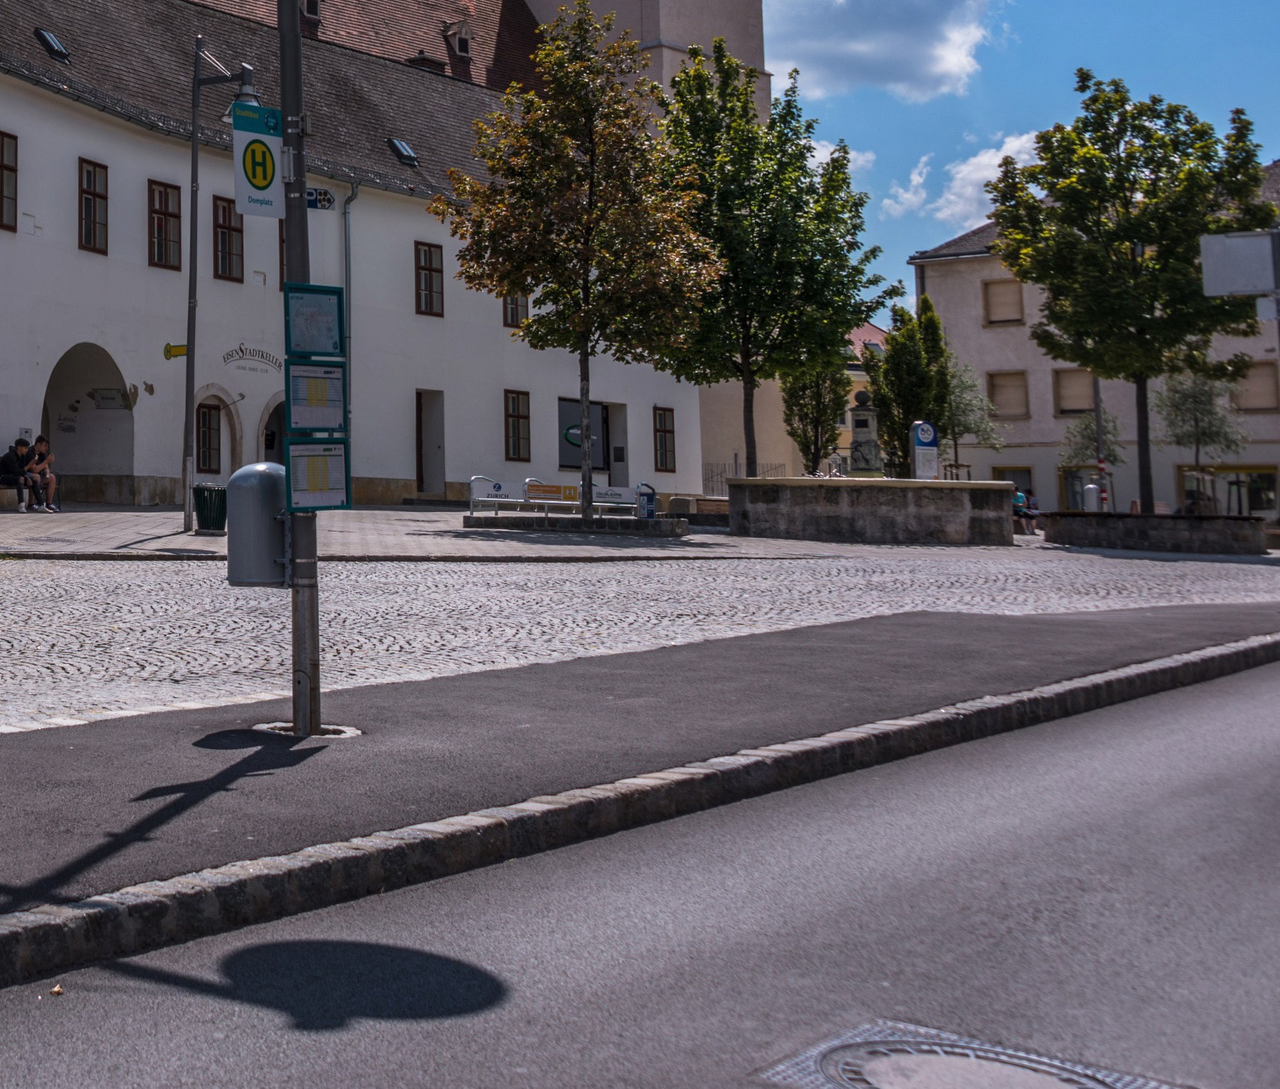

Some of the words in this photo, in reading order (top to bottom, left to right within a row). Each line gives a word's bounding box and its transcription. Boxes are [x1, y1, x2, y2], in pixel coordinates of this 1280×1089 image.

[235, 108, 259, 119] Stadtbus
[251, 148, 267, 181] H
[247, 195, 273, 207] Domplatz
